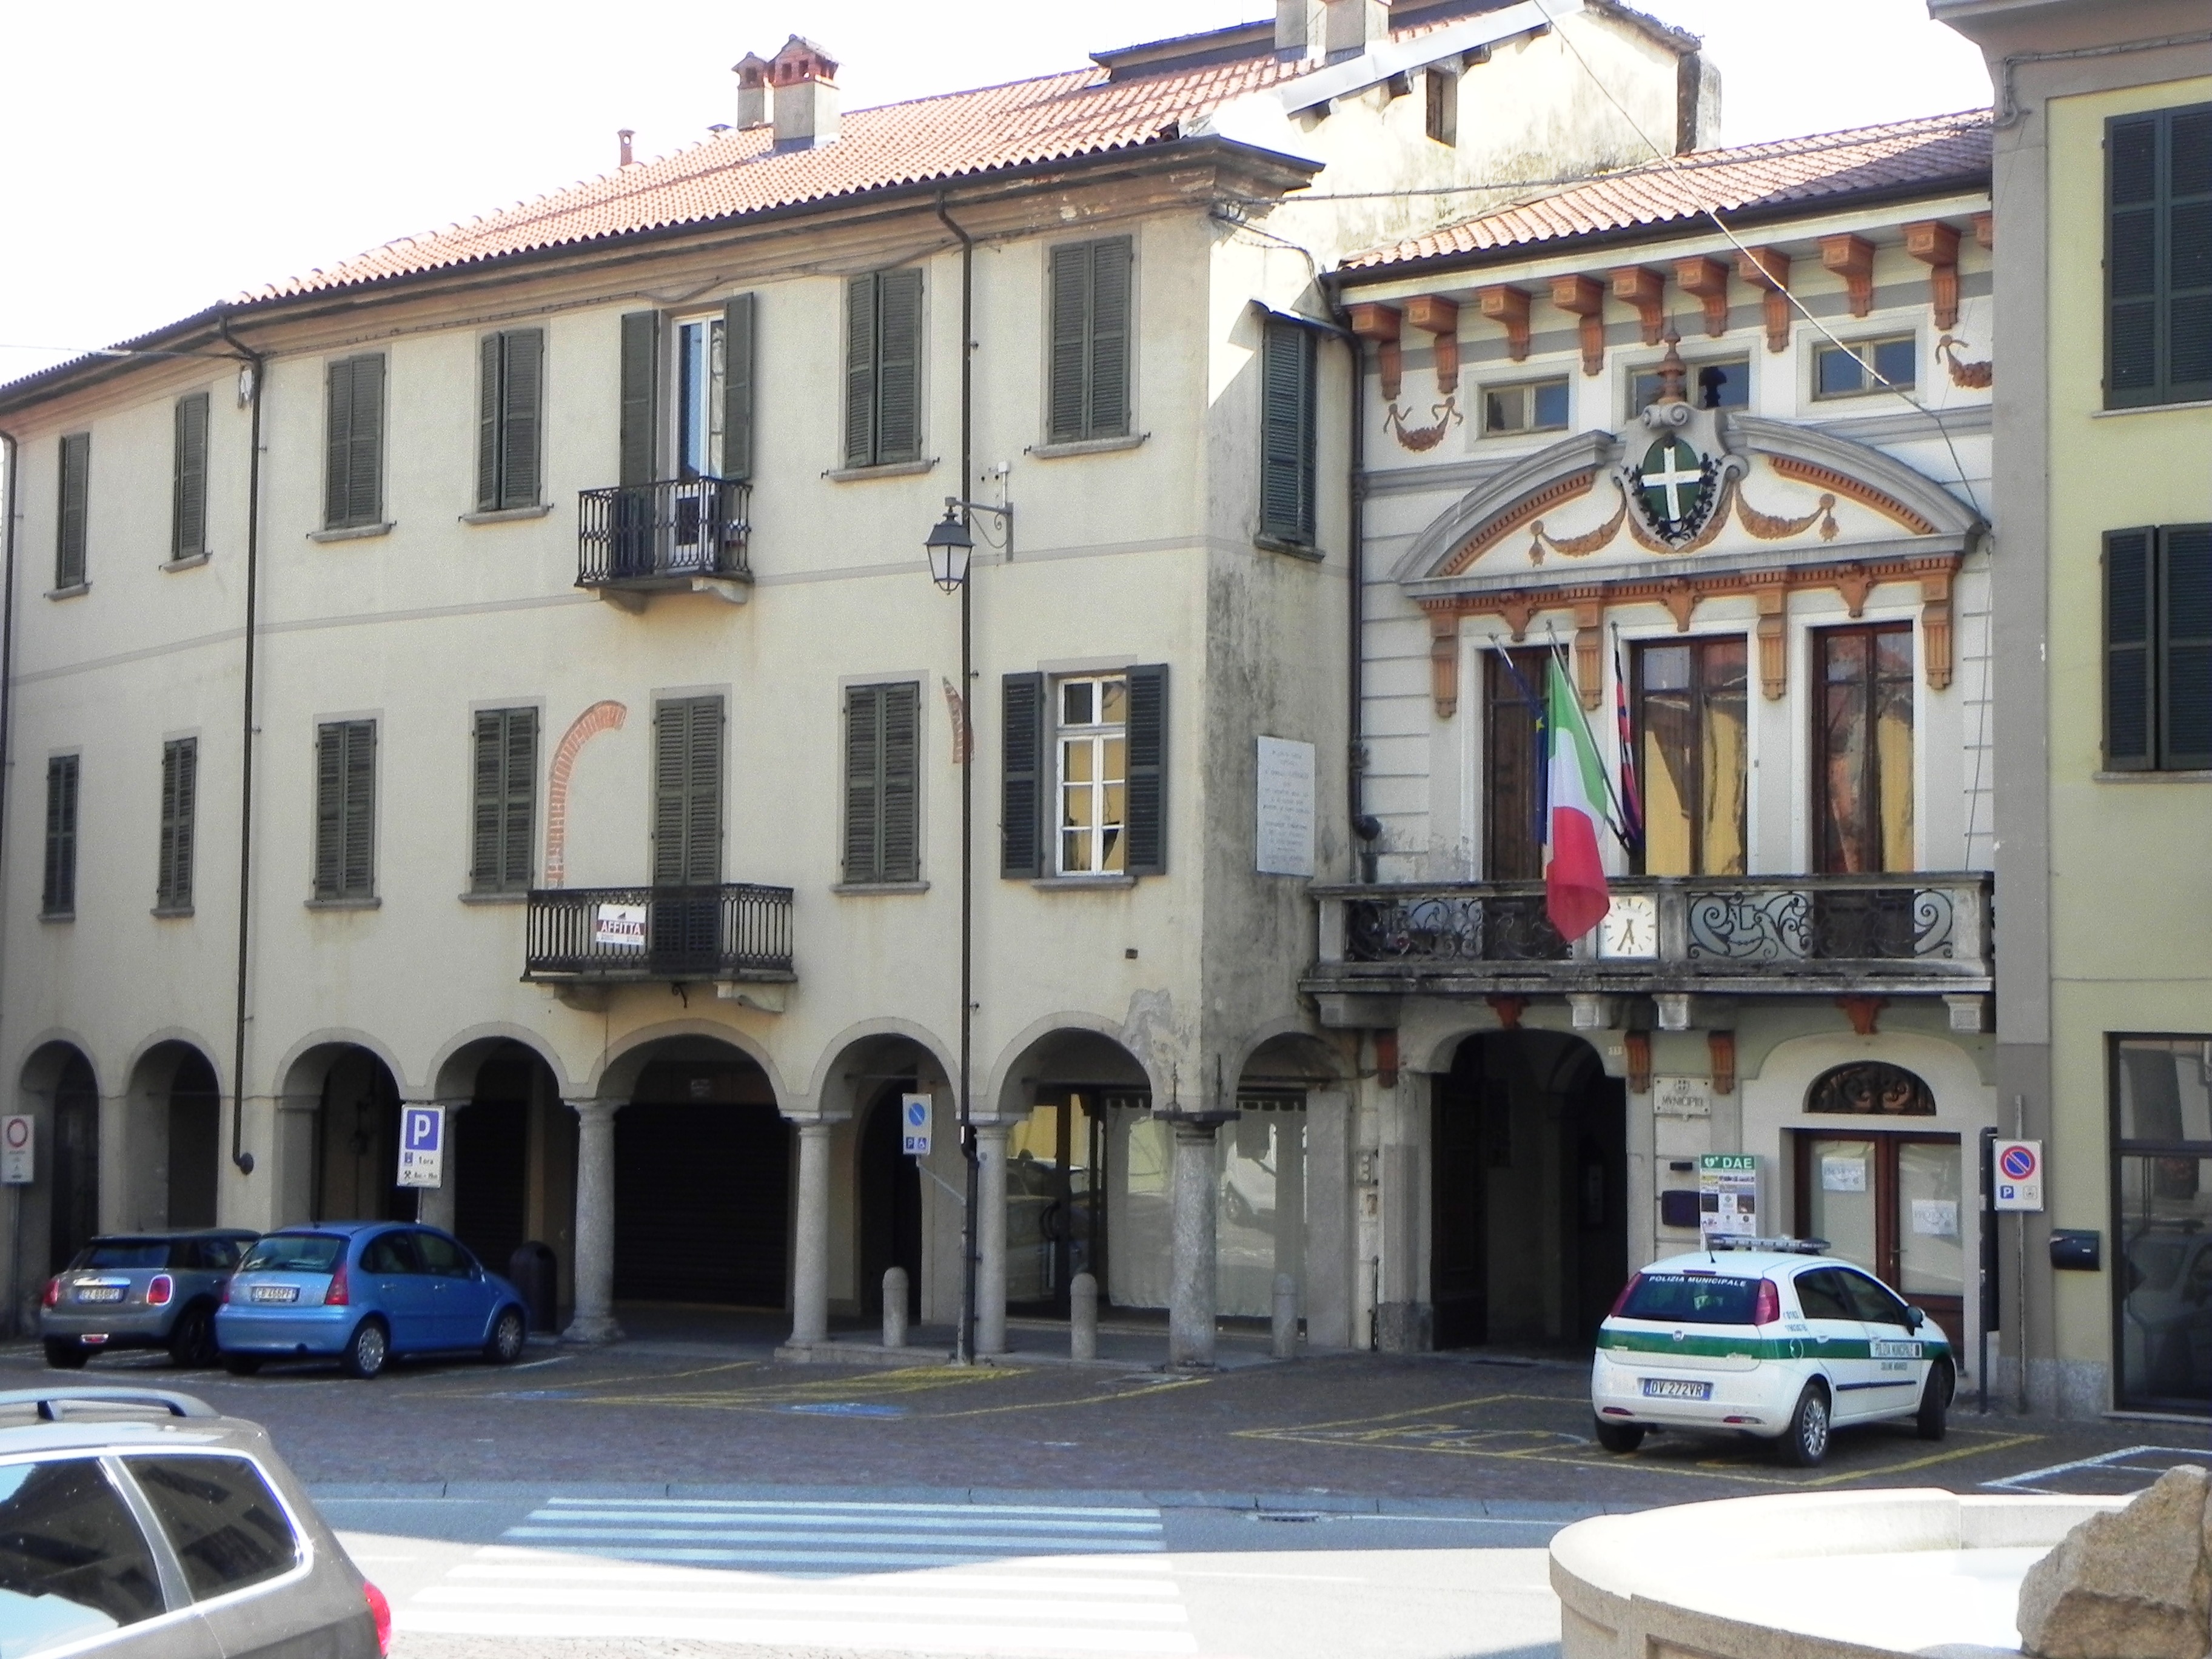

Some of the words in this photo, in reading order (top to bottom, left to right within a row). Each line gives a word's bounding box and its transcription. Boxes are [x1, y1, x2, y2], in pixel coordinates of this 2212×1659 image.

[601, 920, 641, 935] AFFITTA
[414, 1114, 431, 1146] P
[1722, 1157, 1752, 1168] DAE
[2003, 1187, 2012, 1198] P
[1687, 1276, 1747, 1287] MUNICIPALE
[1651, 1381, 1665, 1393] DV
[1668, 1382, 1703, 1396] 272VR
